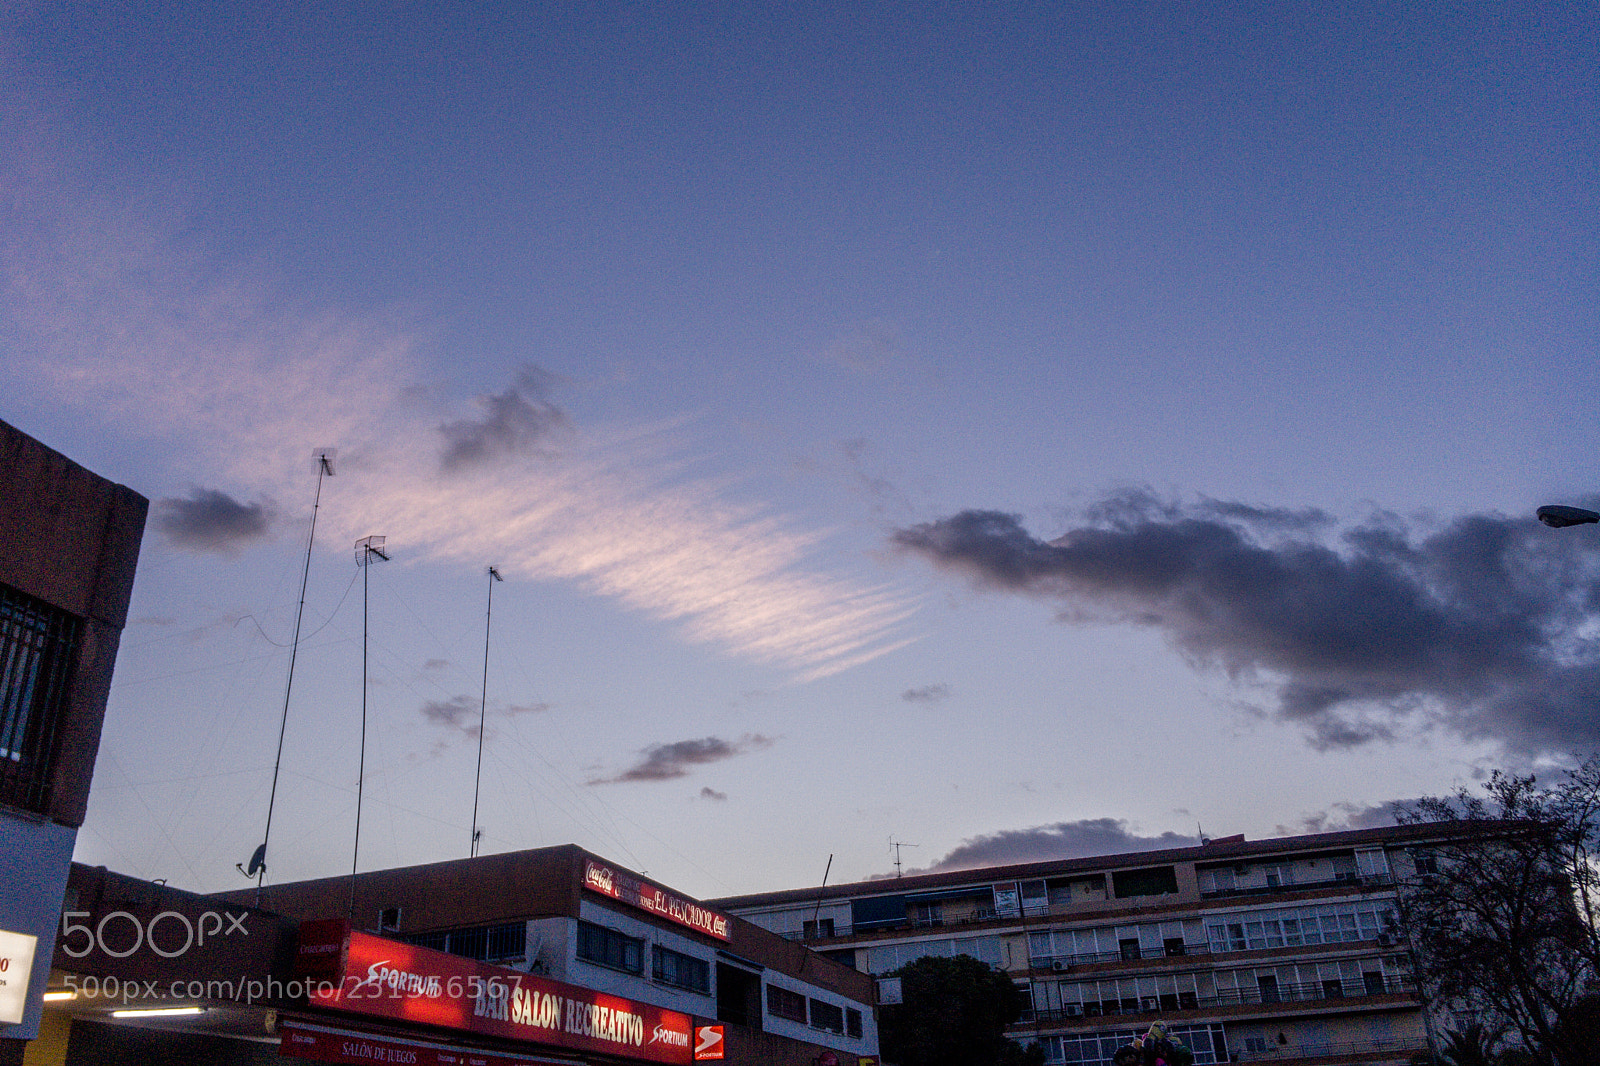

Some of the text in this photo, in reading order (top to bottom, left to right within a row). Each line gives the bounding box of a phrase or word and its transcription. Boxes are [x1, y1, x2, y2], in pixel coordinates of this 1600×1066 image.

[655, 890, 713, 933] EL PESCADOR
[354, 960, 438, 996] SPORTIUM
[474, 979, 643, 1047] BAR SALON RECREATIVO
[342, 1042, 417, 1064] SALÓN DE JUEGOS
[648, 1024, 688, 1047] SPORTIUM
